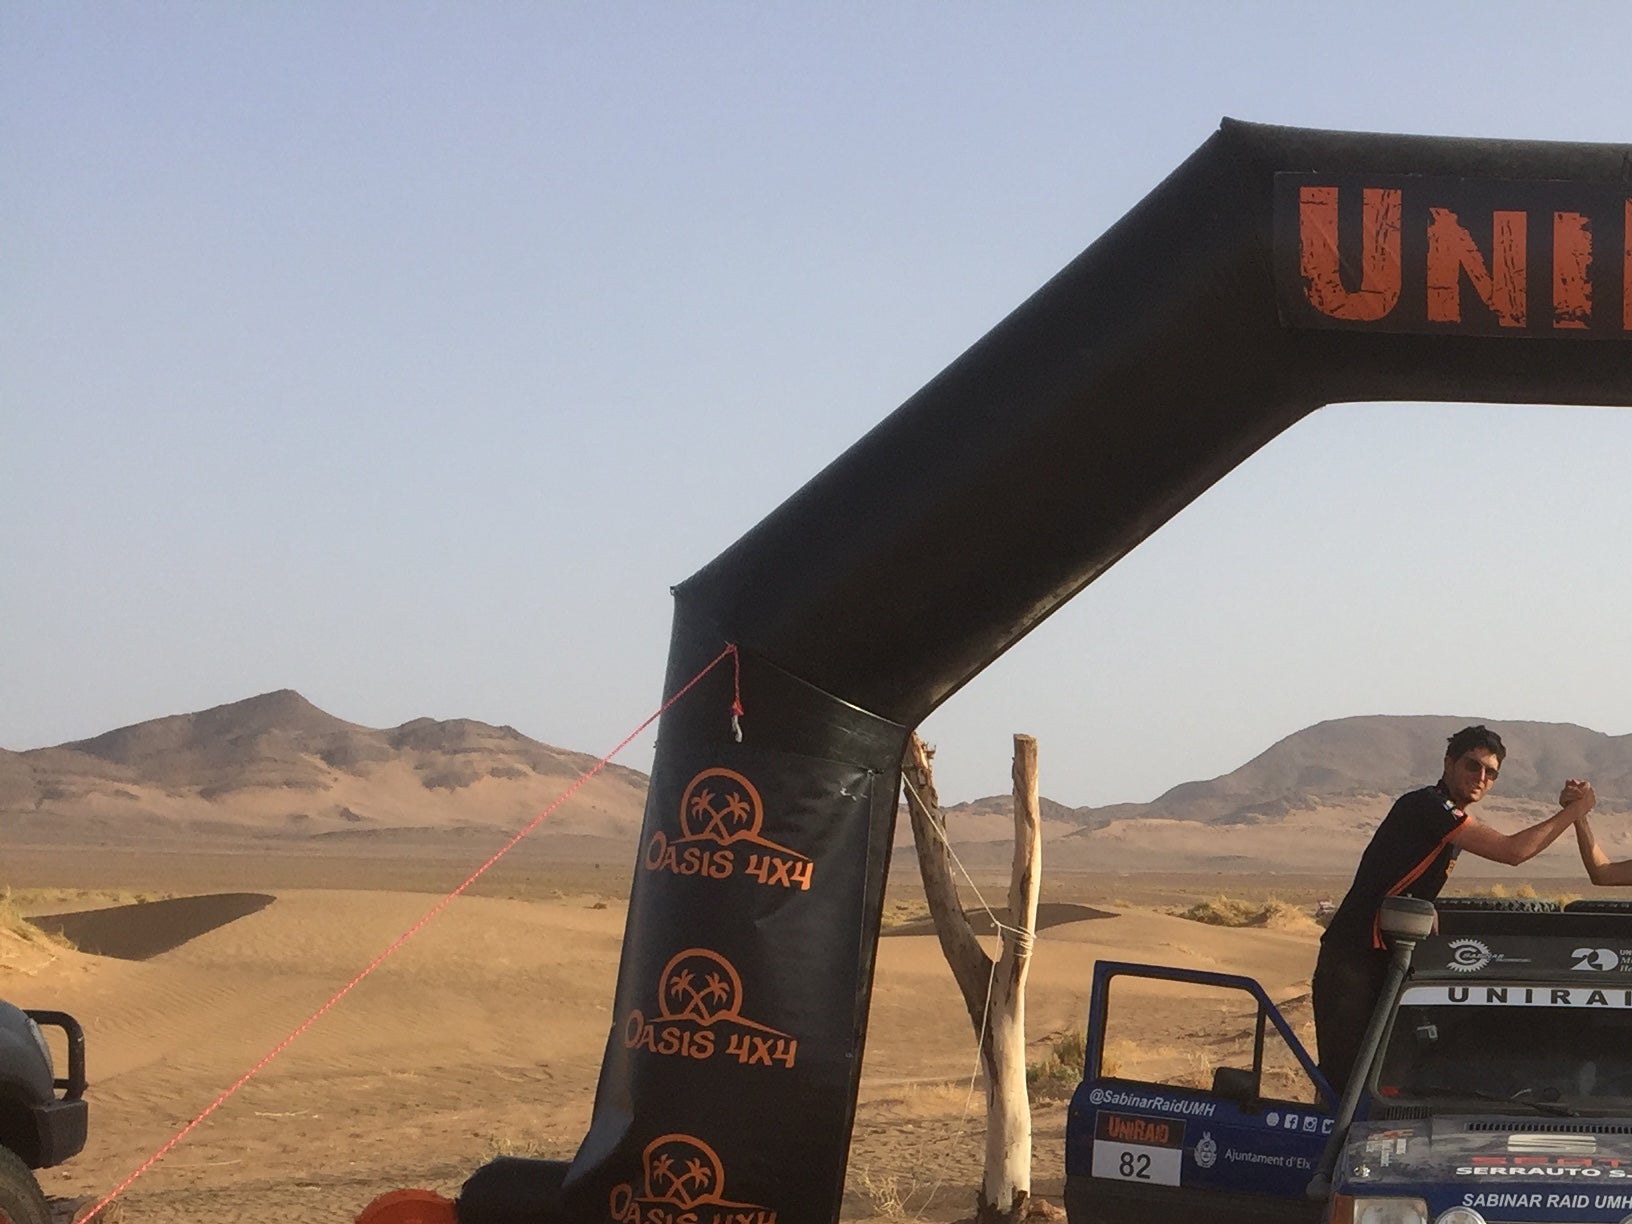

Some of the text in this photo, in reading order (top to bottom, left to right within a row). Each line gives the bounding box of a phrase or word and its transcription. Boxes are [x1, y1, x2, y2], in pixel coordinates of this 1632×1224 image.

[646, 831, 734, 879] OASIS
[1570, 948, 1619, 971] 20
[624, 1010, 715, 1060] OASIS
[1089, 1088, 1217, 1117] @SabinarRaidUMH
[1119, 1151, 1151, 1180] 82
[1224, 1149, 1284, 1167] Ajuntament
[1456, 1166, 1601, 1177] SERRAUTO
[1462, 1193, 1545, 1208] SABINAR
[1546, 1195, 1590, 1209] RAID
